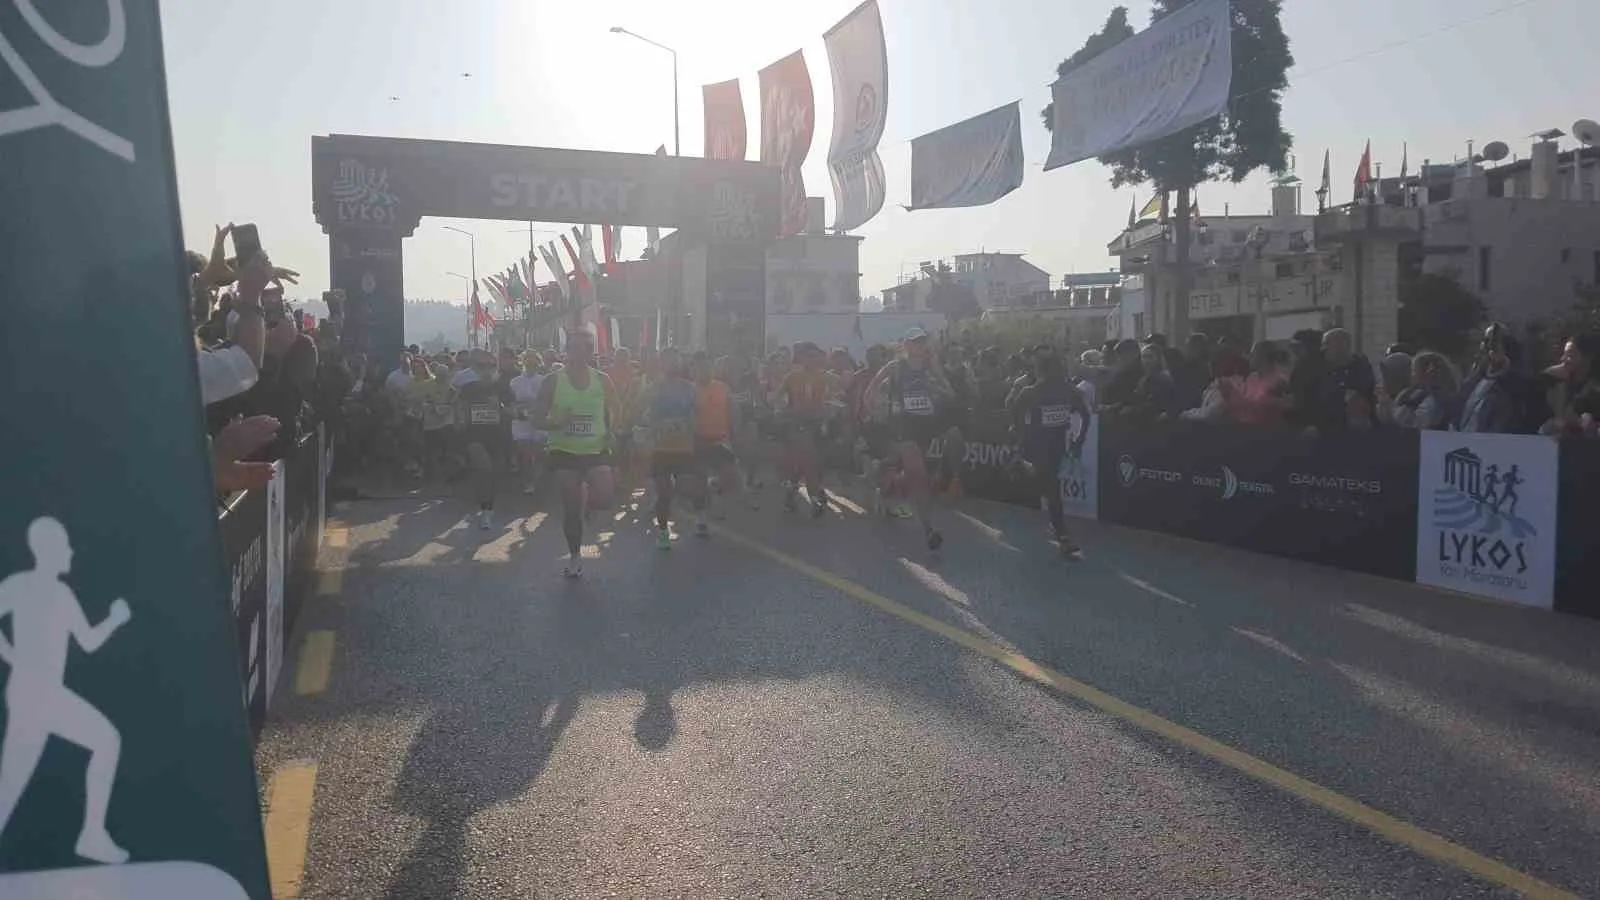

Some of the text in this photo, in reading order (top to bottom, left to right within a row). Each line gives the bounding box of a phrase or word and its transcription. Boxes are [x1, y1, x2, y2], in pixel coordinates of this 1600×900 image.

[490, 173, 635, 216] START
[336, 201, 397, 224] LYKOS
[1061, 476, 1088, 500] KOS
[1288, 471, 1383, 494] GAMATEKS
[1439, 530, 1528, 575] LYKOS
